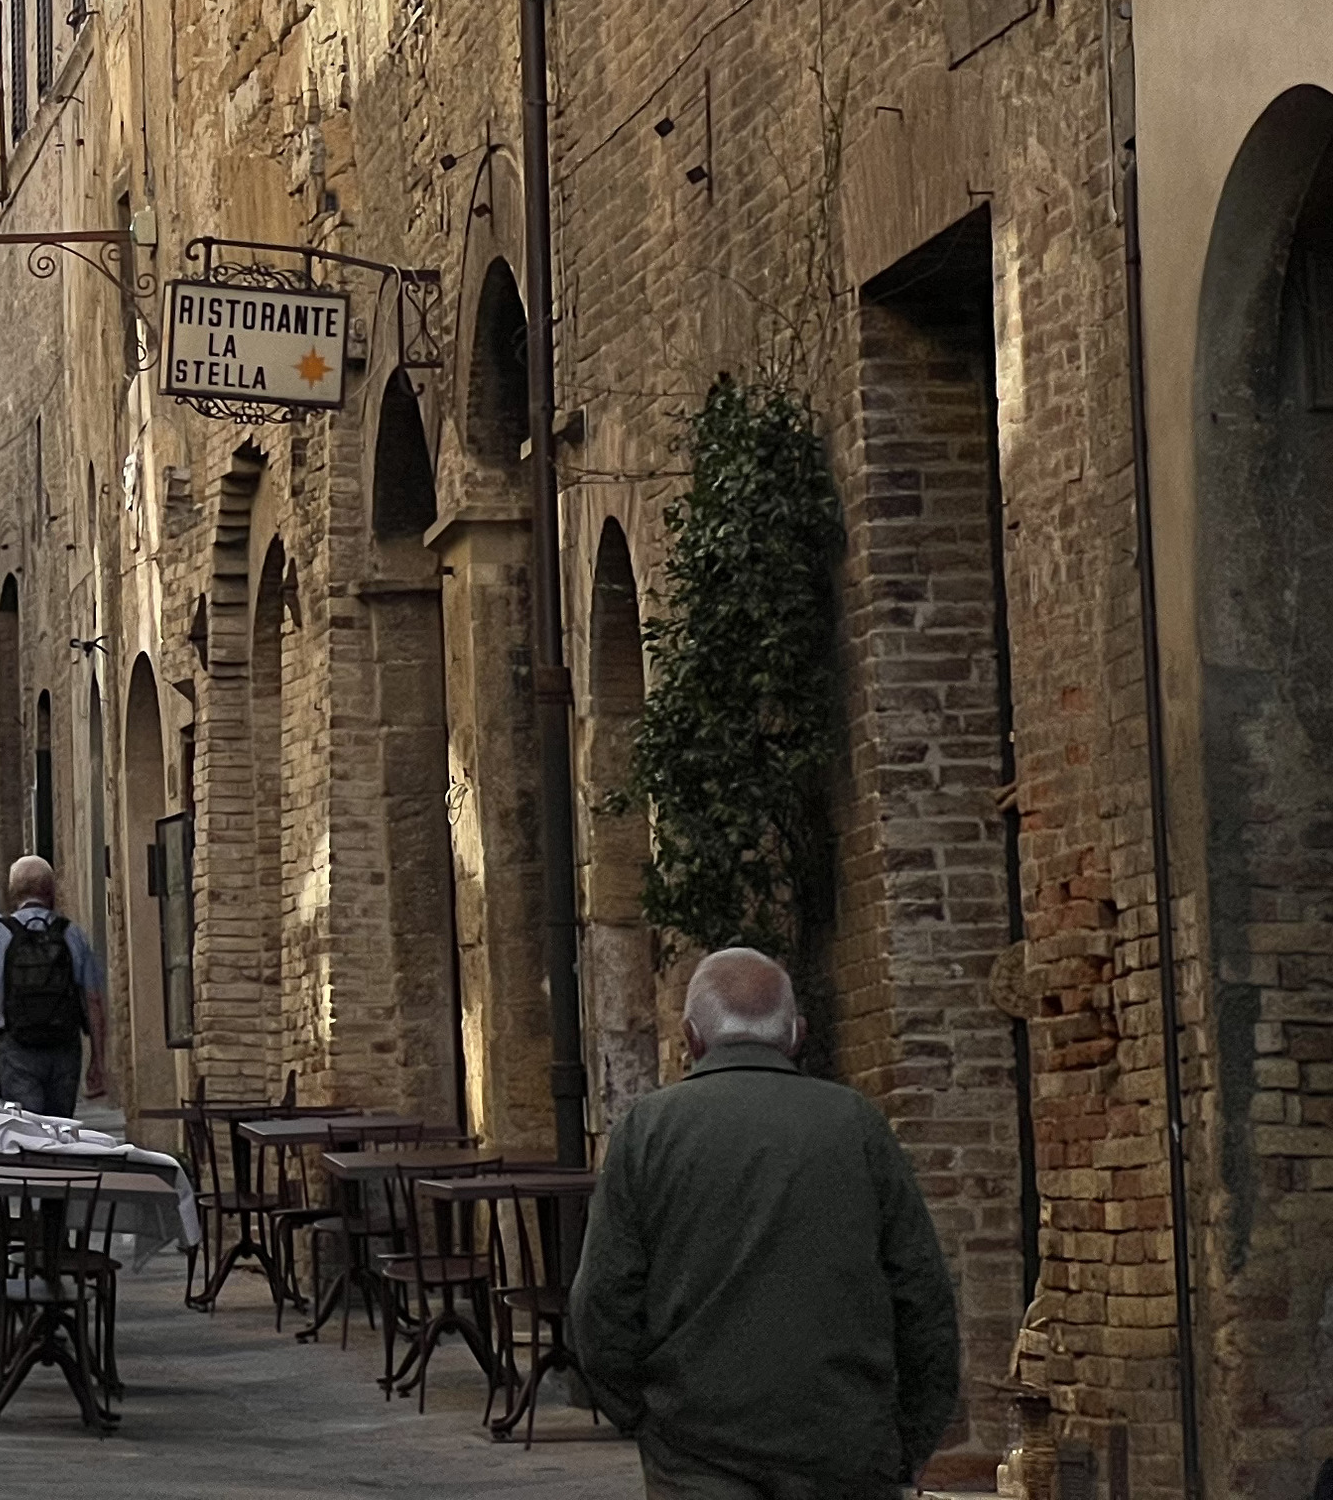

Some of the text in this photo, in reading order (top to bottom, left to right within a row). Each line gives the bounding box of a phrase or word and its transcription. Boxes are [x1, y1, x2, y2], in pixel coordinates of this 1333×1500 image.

[179, 295, 339, 337] RISTORANTE
[208, 333, 236, 358] LA
[175, 360, 266, 390] STELLA
